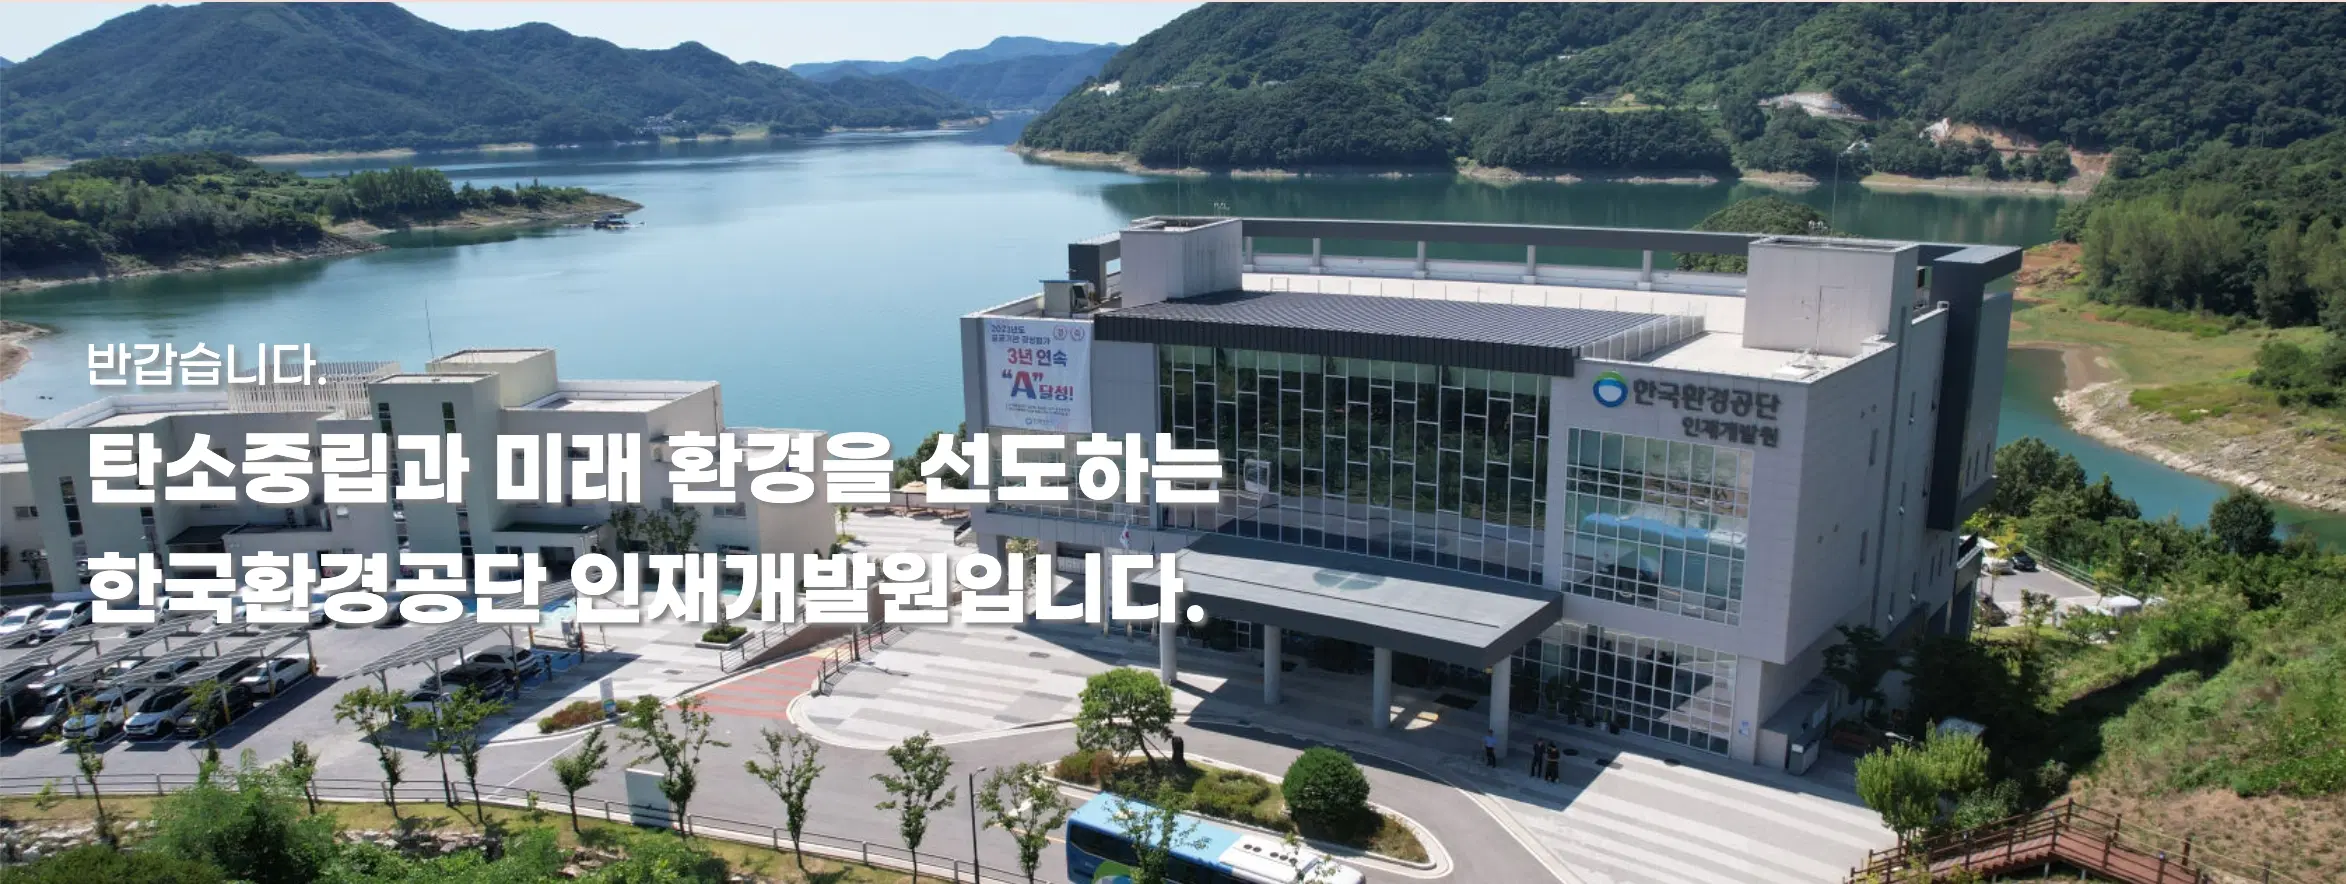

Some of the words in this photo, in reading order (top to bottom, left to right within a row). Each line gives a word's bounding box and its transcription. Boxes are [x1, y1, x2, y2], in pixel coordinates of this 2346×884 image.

[1007, 347, 1033, 366] 3년
[1036, 349, 1068, 367] 연속
[1039, 384, 1074, 401] 달성!
[1632, 377, 1781, 421] 한국환경공단
[1682, 416, 1780, 448] 인재개발원
